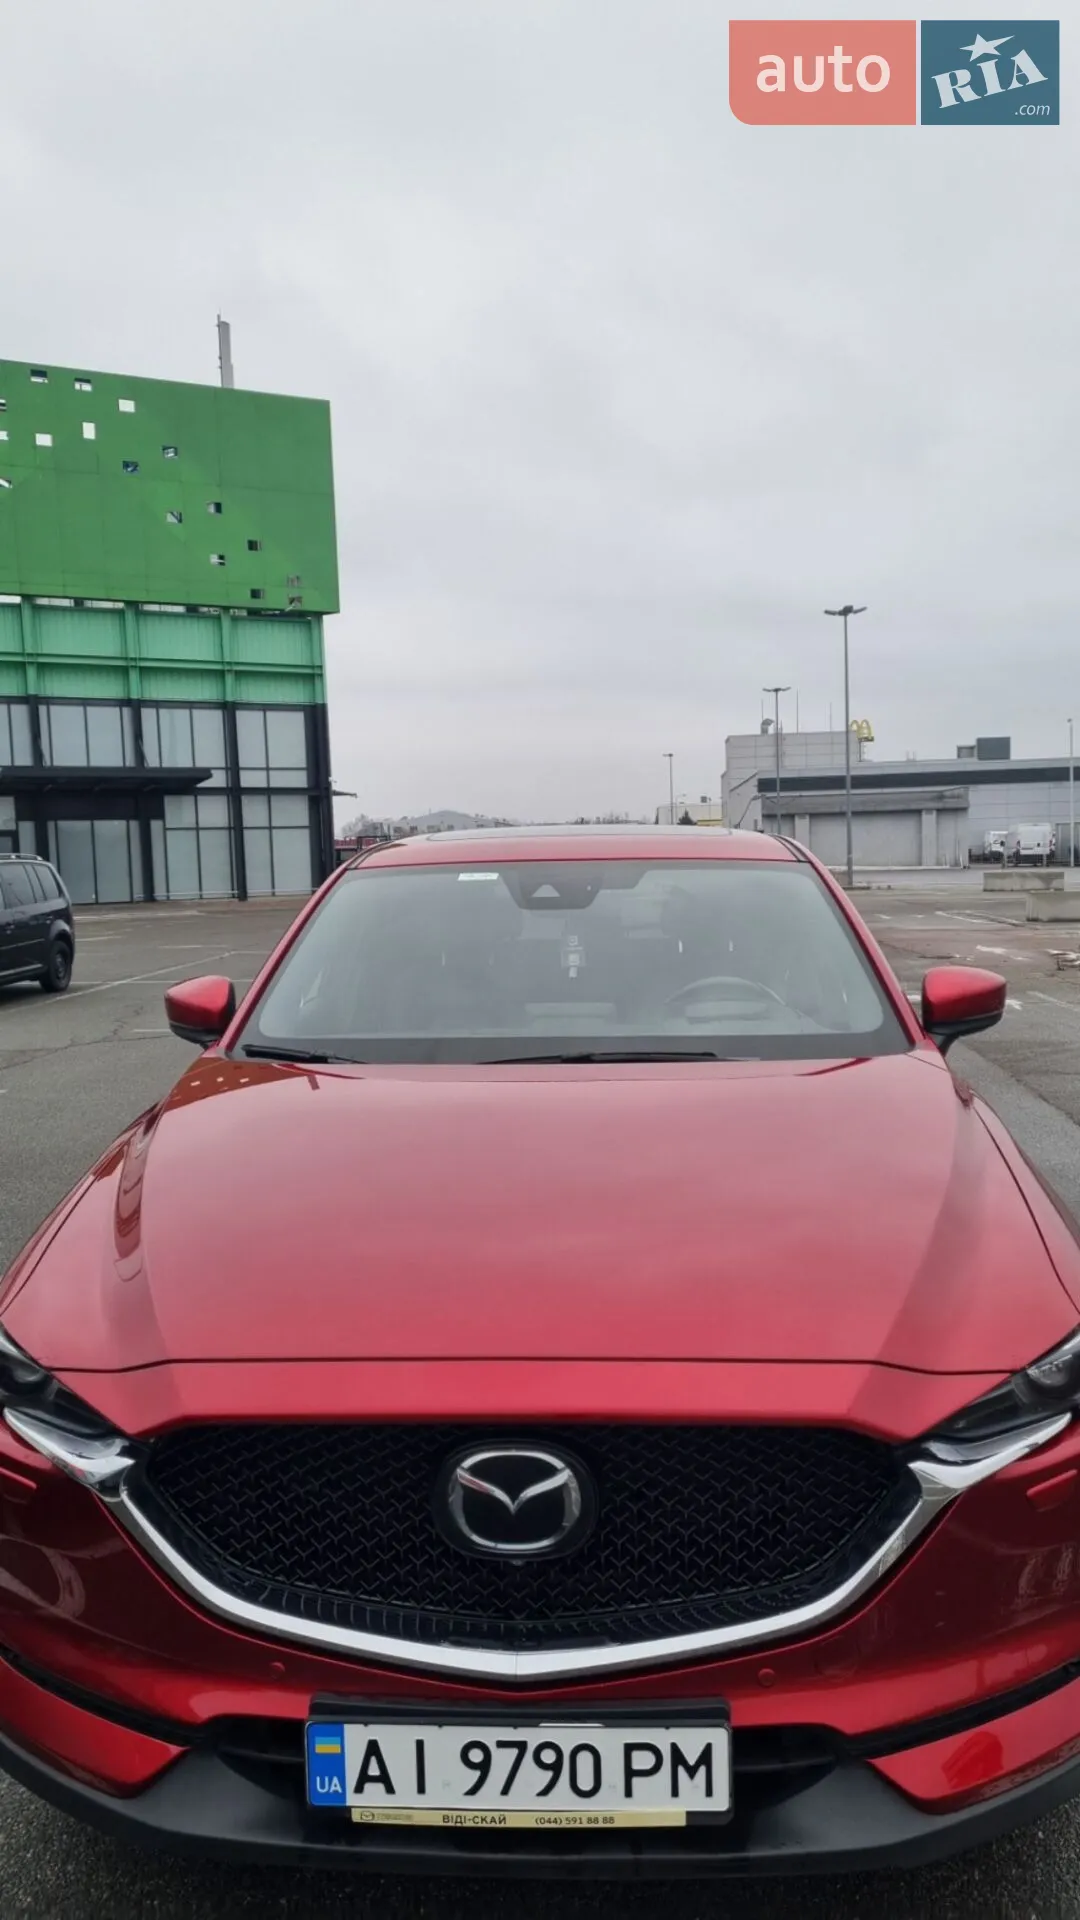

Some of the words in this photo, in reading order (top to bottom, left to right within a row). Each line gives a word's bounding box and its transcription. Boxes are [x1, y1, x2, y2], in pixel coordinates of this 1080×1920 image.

[353, 1739, 426, 1796] AI
[460, 1740, 602, 1798] 9790
[624, 1742, 713, 1798] PM
[316, 1777, 342, 1793] UA
[535, 1816, 563, 1827] (044)
[565, 1816, 583, 1826] 591
[586, 1816, 599, 1826] 88
[602, 1815, 616, 1825] 88
